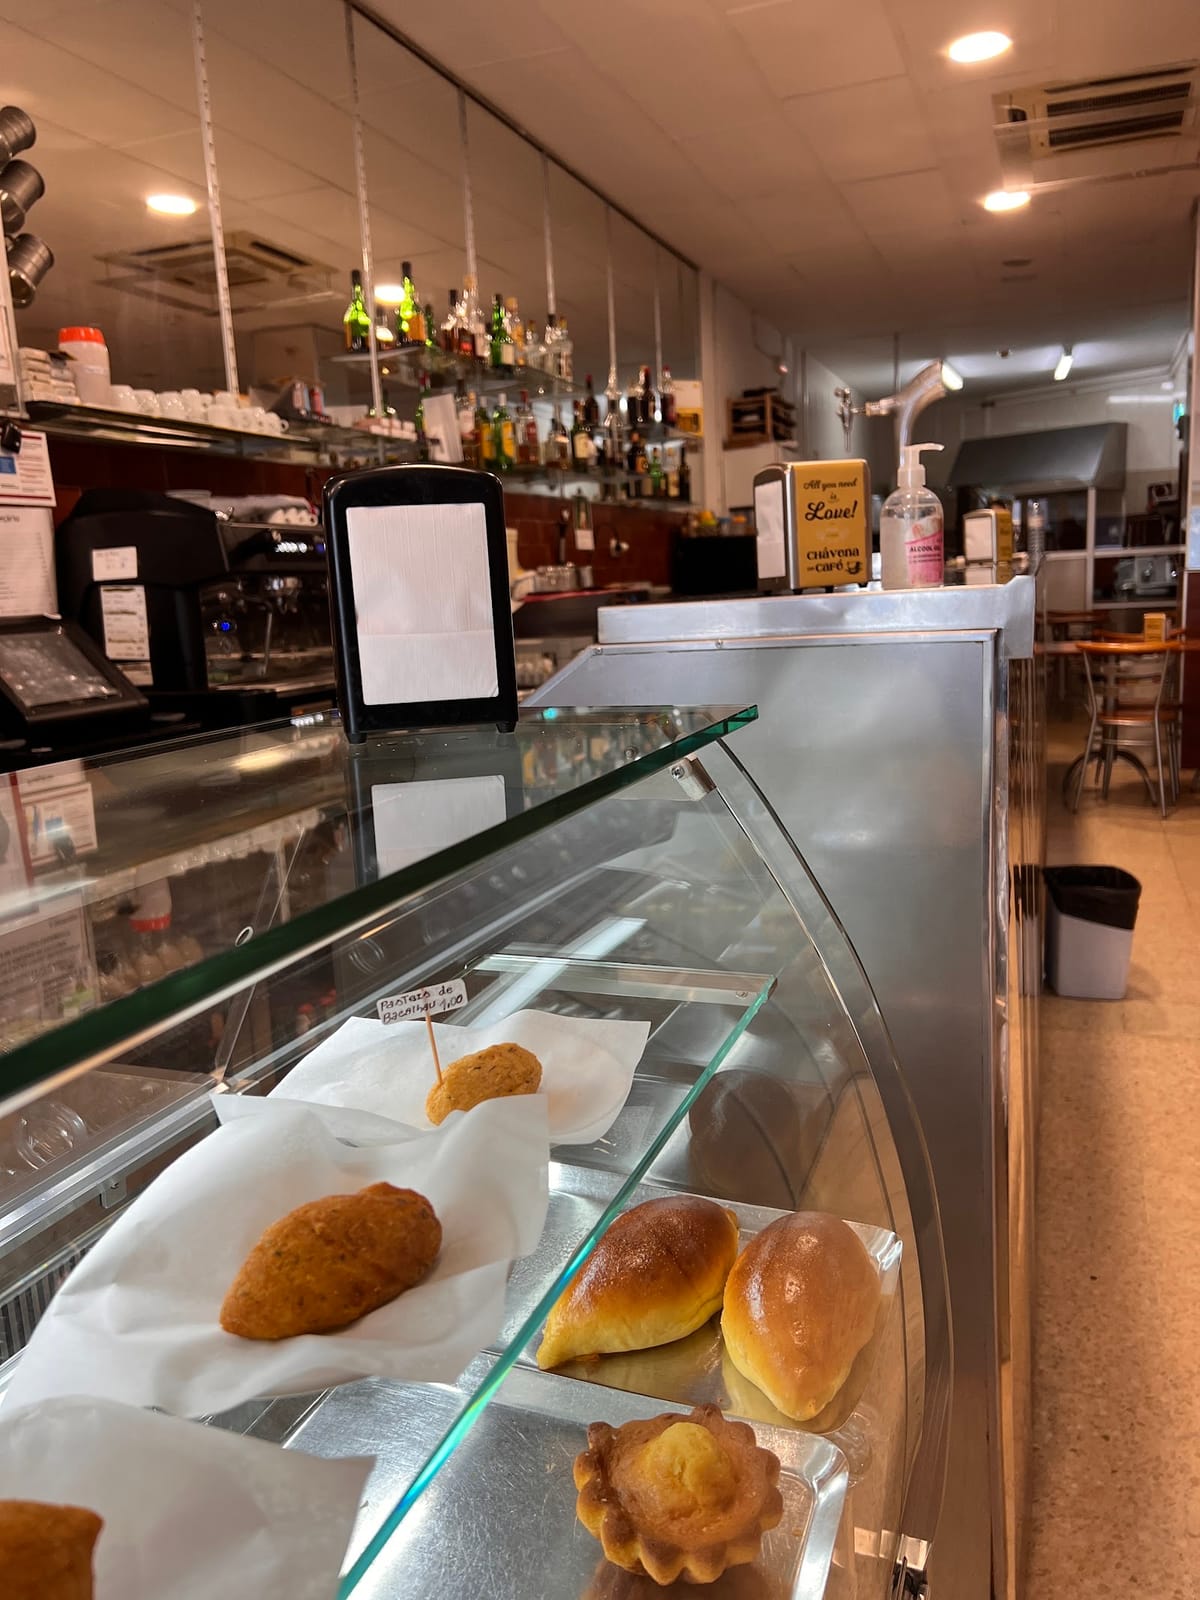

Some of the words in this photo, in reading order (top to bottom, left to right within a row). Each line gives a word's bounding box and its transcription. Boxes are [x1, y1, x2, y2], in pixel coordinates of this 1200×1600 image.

[803, 480, 821, 490] All
[822, 482, 837, 492] you
[838, 478, 858, 488] need
[804, 500, 858, 521] Love!
[438, 985, 453, 996] de
